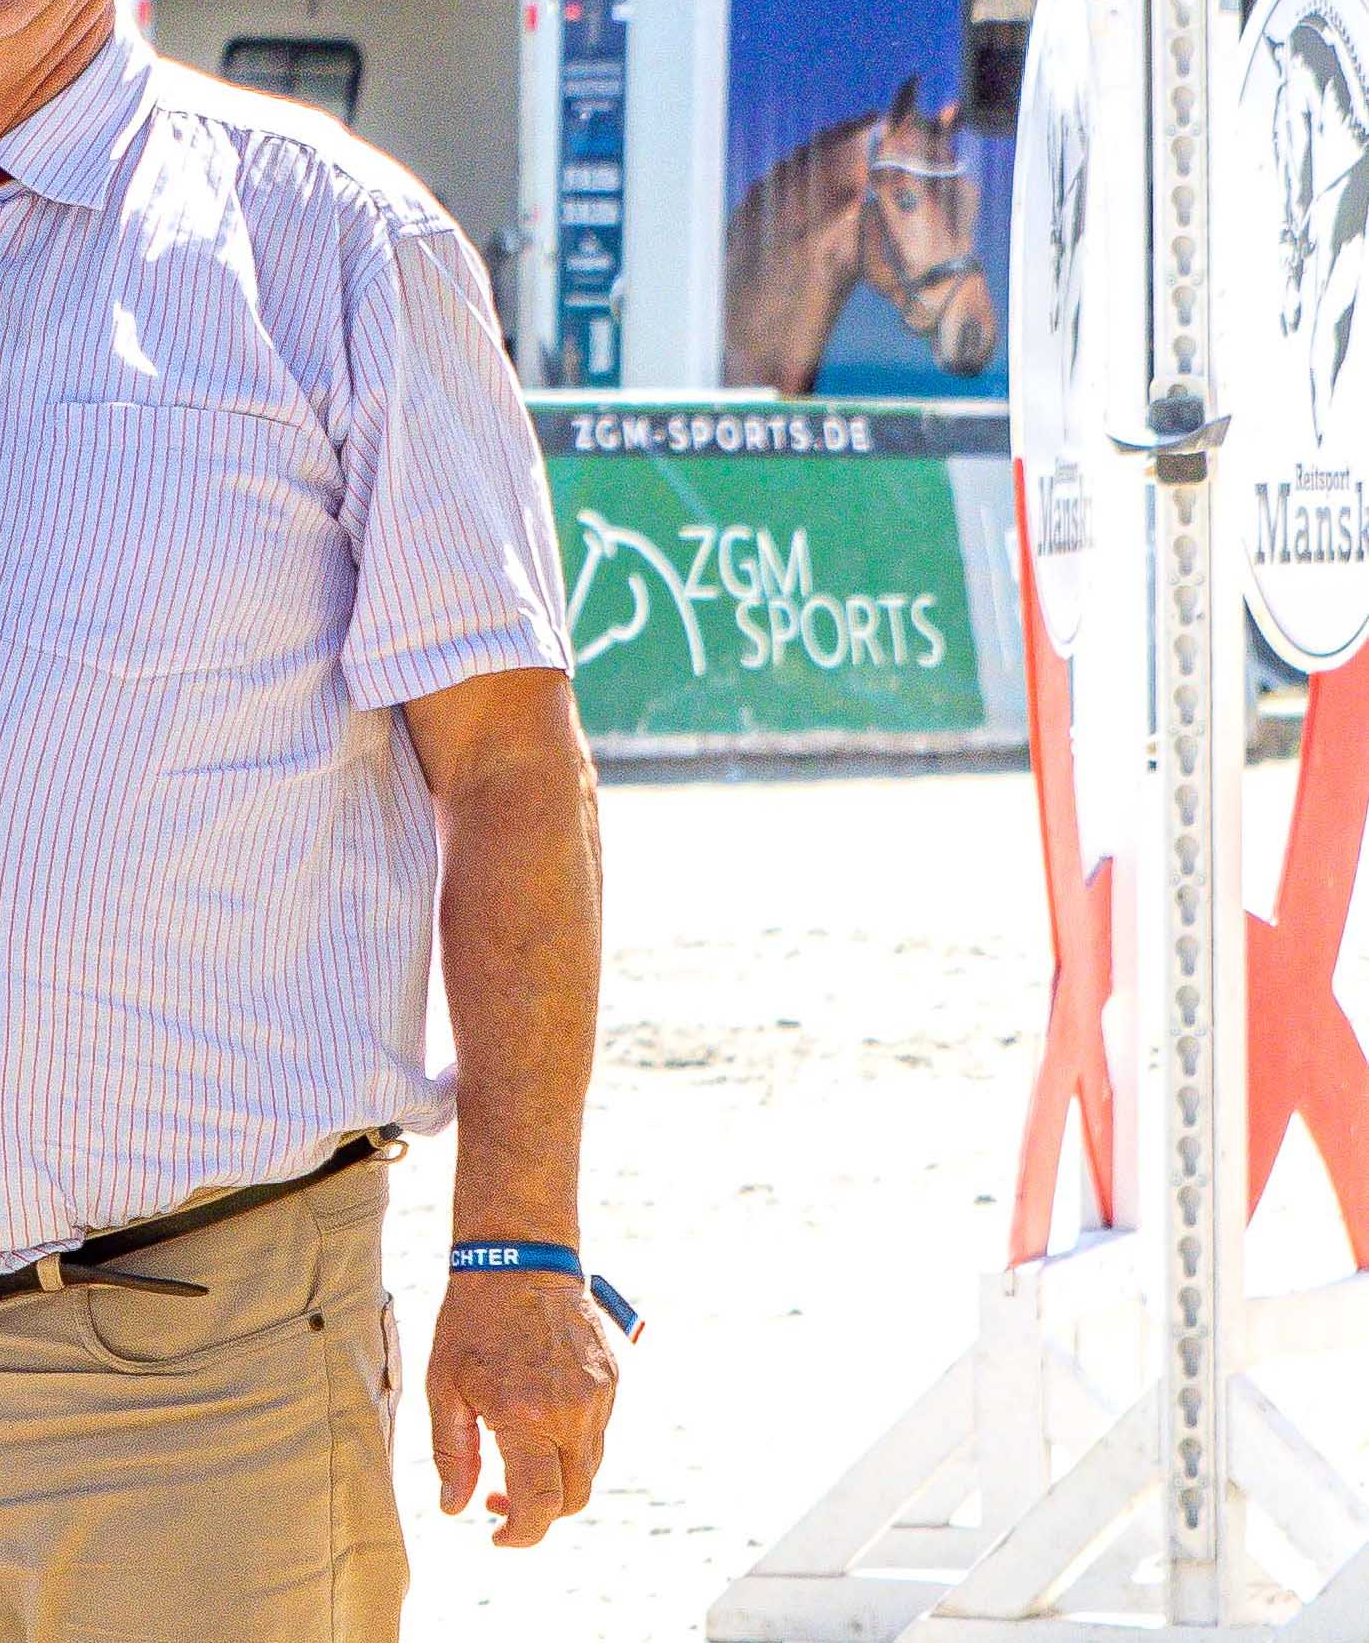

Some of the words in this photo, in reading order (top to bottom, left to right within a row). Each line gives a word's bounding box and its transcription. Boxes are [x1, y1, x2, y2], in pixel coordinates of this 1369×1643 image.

[571, 414, 873, 453] ZGM-SPORTS.DE
[1294, 462, 1351, 495] Reitsport
[680, 524, 813, 600] ZGM
[735, 593, 946, 670] SPORTS
